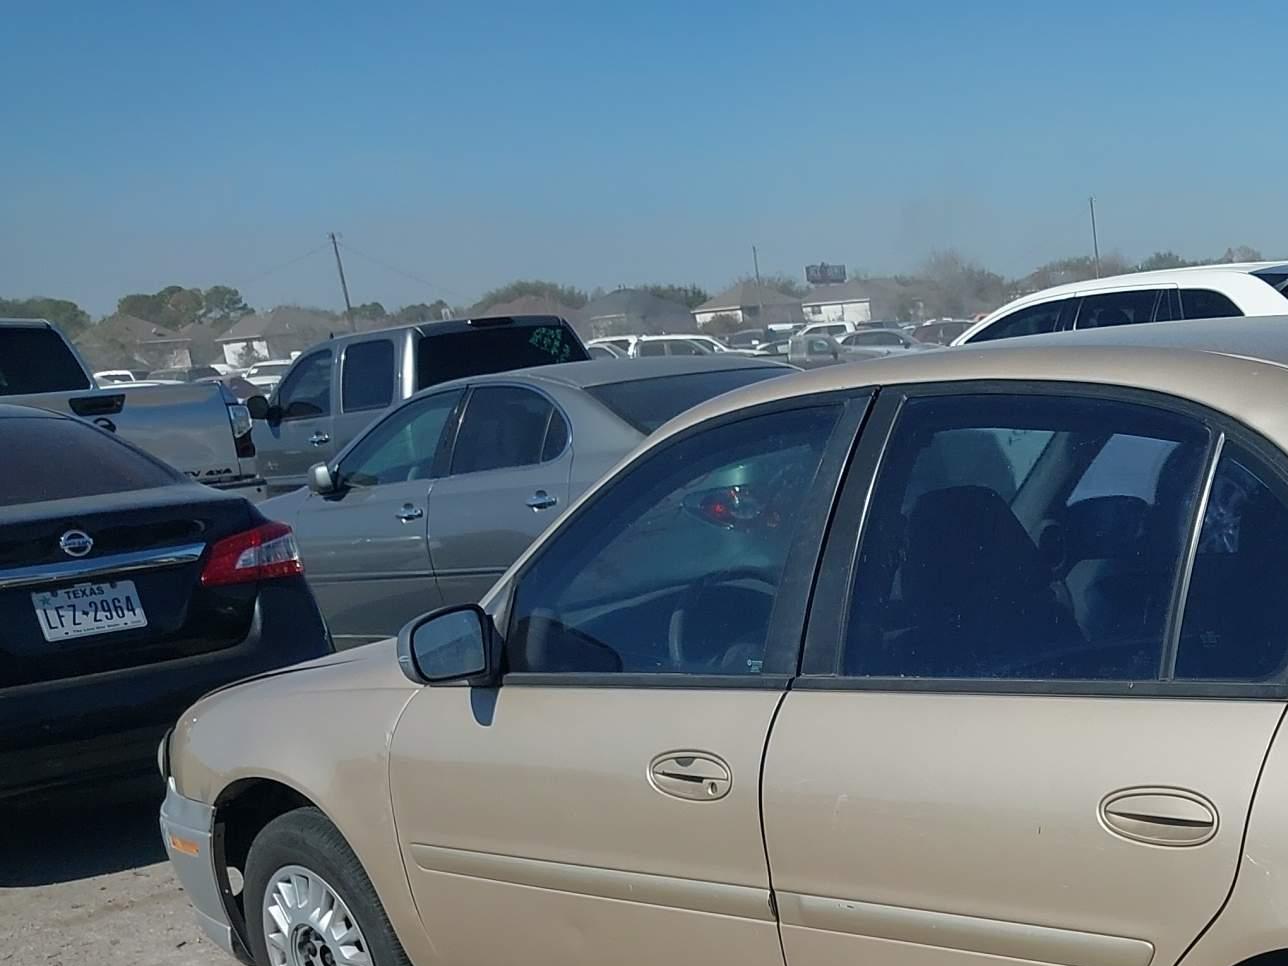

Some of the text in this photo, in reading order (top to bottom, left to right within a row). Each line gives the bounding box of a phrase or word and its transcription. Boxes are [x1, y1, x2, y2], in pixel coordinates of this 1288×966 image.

[64, 586, 105, 600] TEXAS
[43, 595, 137, 630] LFZ 2964
